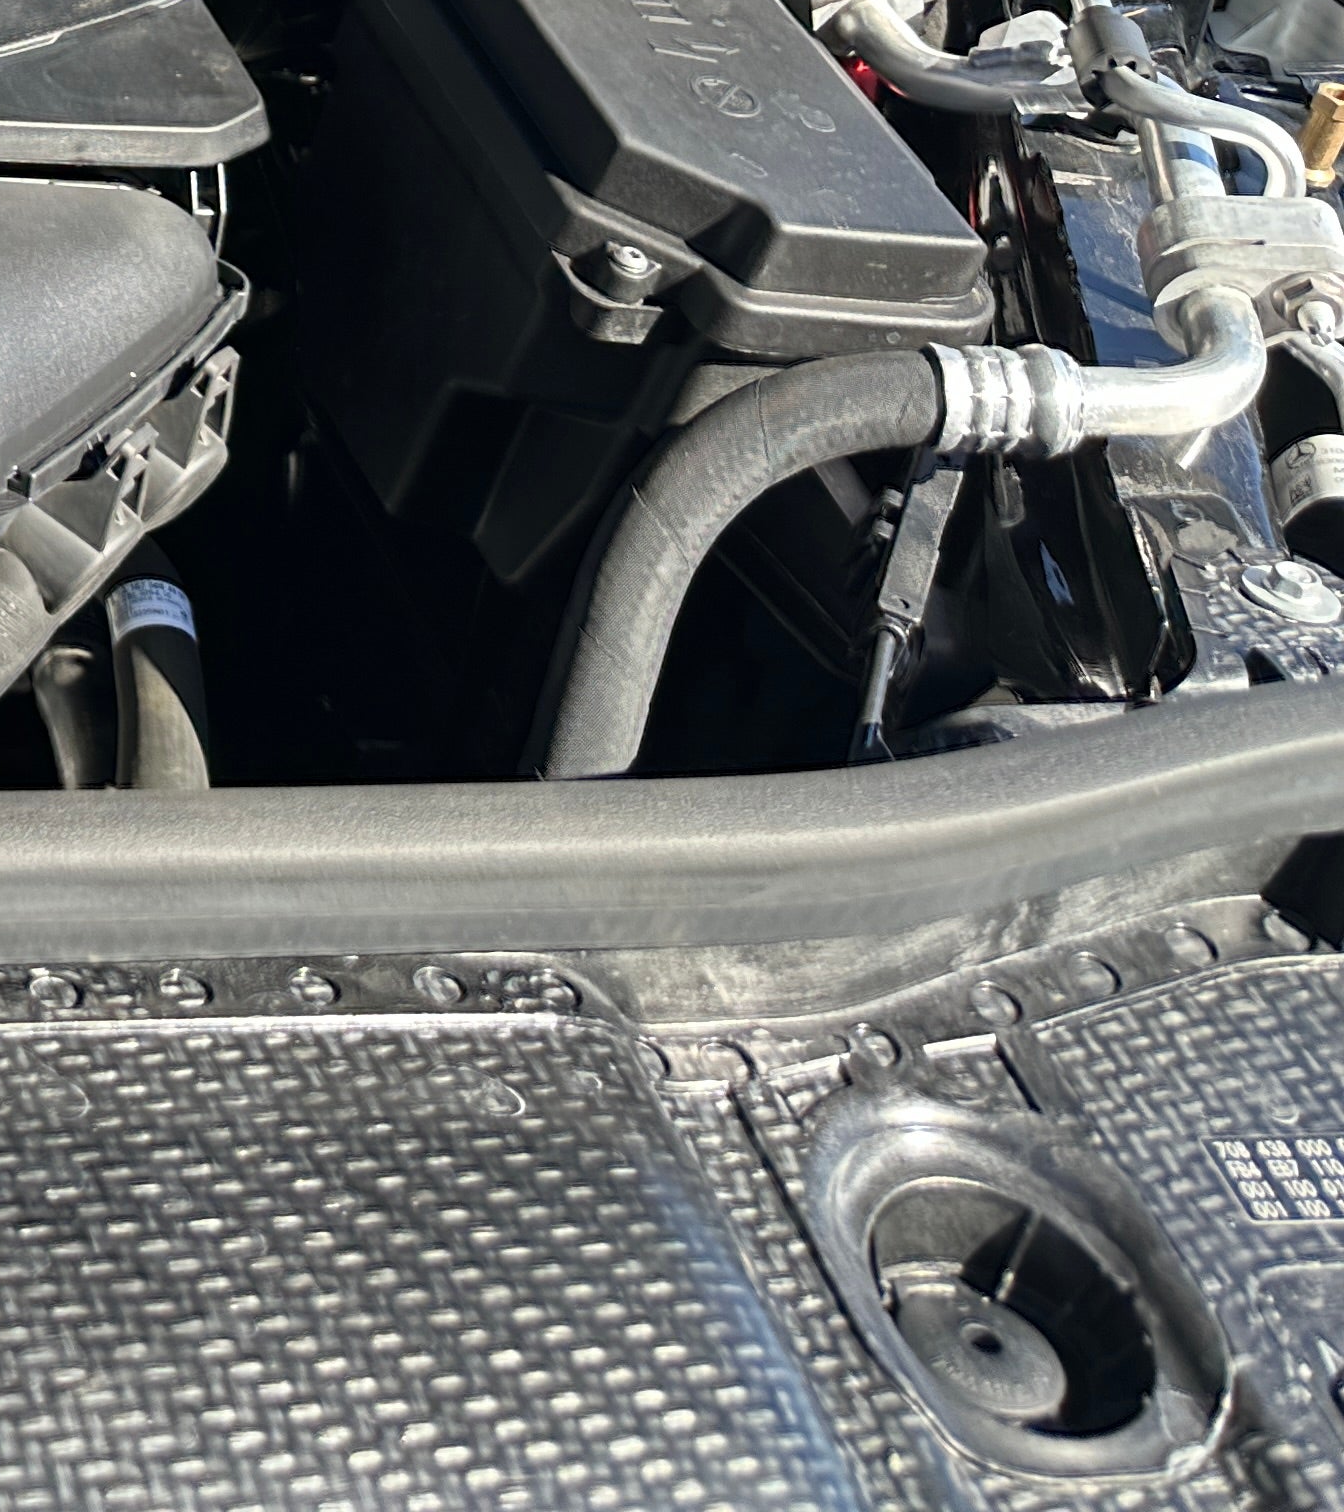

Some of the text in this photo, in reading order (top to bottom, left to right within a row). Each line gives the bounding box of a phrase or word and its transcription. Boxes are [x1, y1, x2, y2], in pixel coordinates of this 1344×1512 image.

[1295, 1138, 1333, 1157] 000
[1311, 1158, 1344, 1177] 110
[1238, 1180, 1276, 1199] 001
[1281, 1179, 1318, 1198] 100
[1252, 1200, 1289, 1219] 001
[1295, 1199, 1331, 1218] 100
